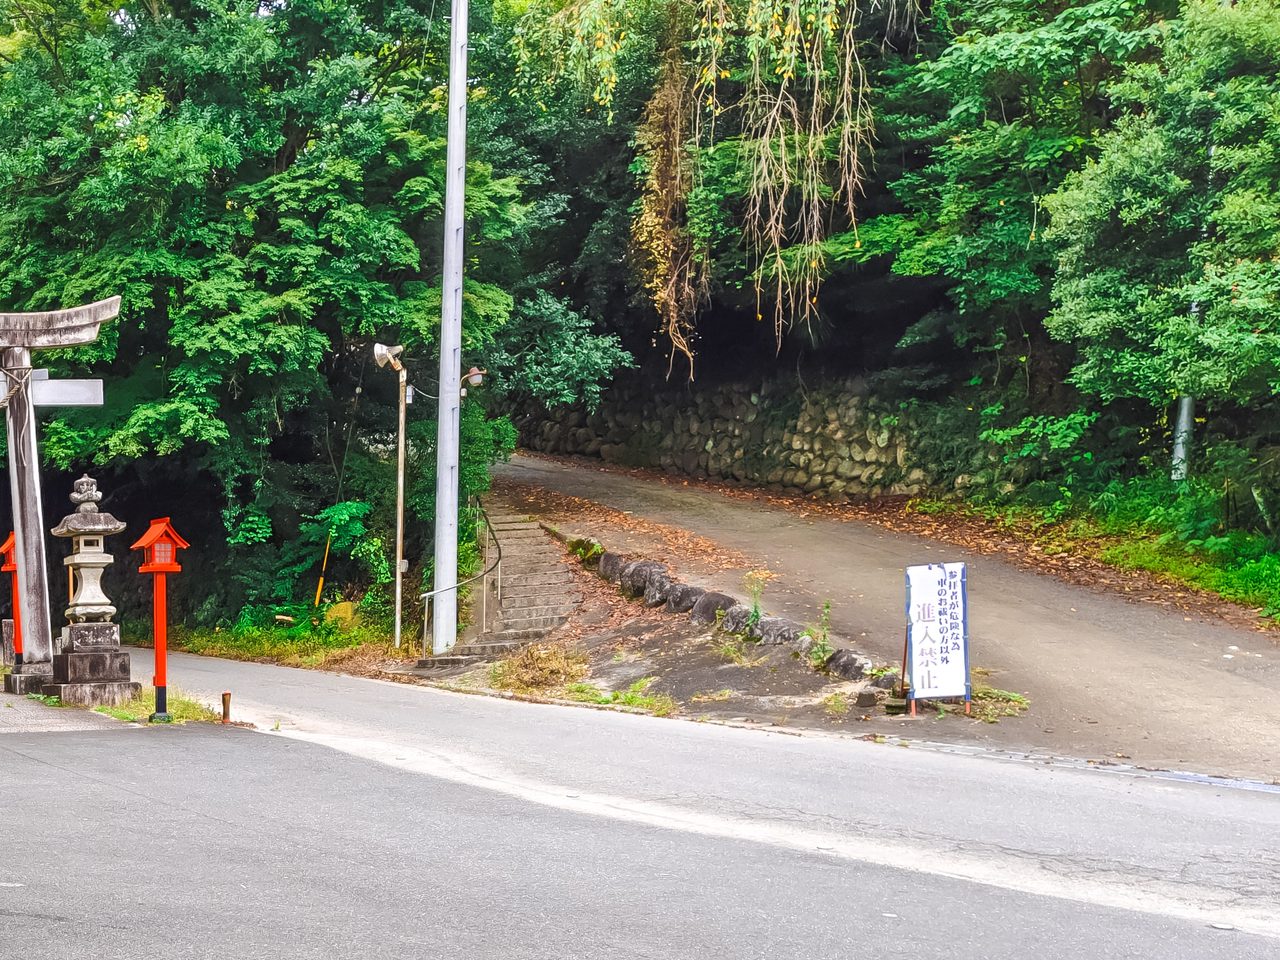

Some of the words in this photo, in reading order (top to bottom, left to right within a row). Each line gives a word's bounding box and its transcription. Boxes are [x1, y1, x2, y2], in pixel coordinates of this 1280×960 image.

[916, 602, 939, 690] 進入禁止
[937, 578, 950, 665] 車のお祓いの方以外
[948, 570, 960, 651] 参拝者が危険な為
